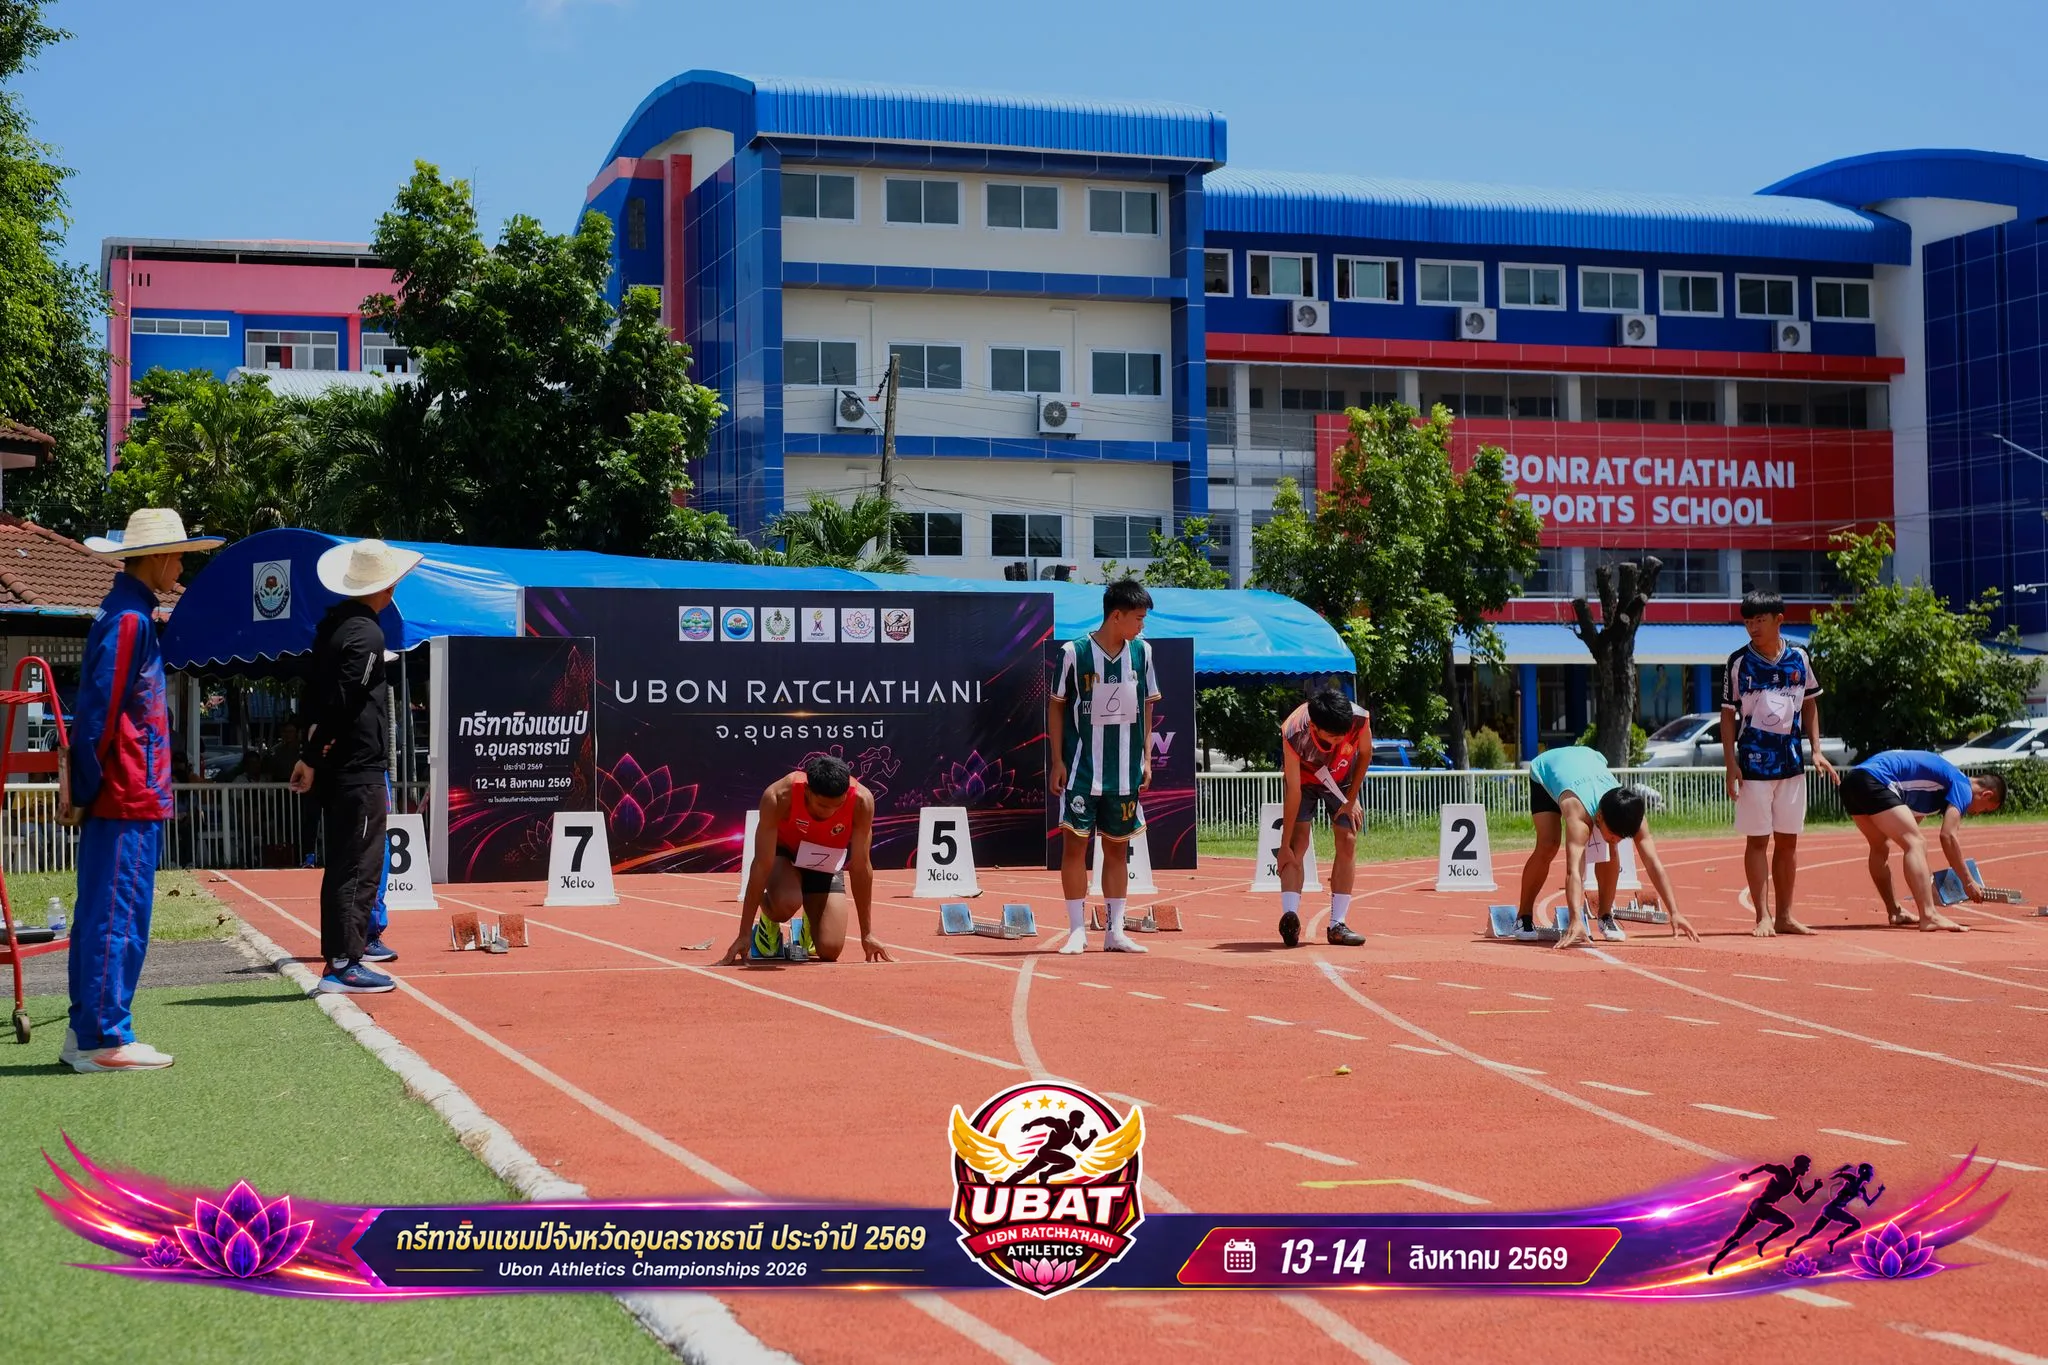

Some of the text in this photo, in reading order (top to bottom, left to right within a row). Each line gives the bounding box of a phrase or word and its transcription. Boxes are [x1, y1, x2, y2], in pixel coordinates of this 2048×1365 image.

[1500, 453, 1796, 489] BONRATCHATHANI
[1652, 496, 1773, 526] SCHOOL
[615, 680, 982, 704] UBON RATCHATHANI
[1105, 686, 1122, 713] 6
[716, 719, 885, 745] จ.อุบลราชธานี
[474, 738, 570, 761] จ.อุบลราชธานี
[509, 777, 545, 789] สิงหาคม
[547, 777, 572, 788] 2569
[386, 827, 412, 875] 8
[564, 826, 594, 873] 7
[931, 821, 957, 866] 5
[1450, 818, 1478, 861] 2
[386, 878, 414, 892] elco
